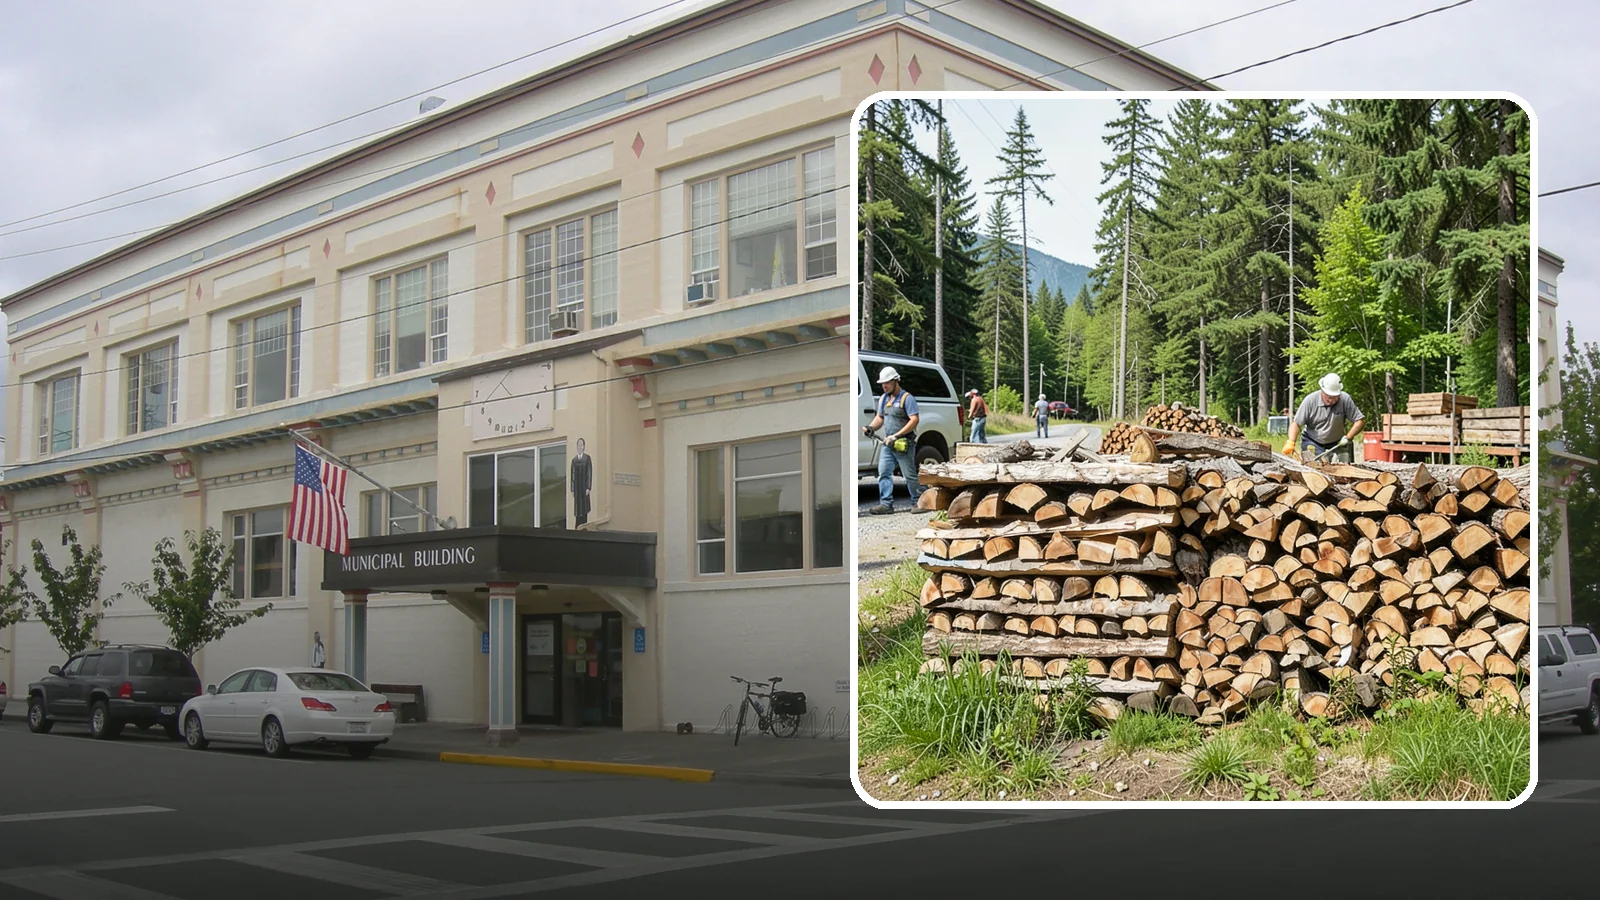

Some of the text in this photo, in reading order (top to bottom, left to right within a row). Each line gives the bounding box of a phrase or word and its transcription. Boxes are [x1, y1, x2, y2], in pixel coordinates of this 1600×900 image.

[476, 390, 479, 398] 7
[481, 407, 484, 415] 8
[342, 546, 474, 572] MUNICIPAL BUILDING
